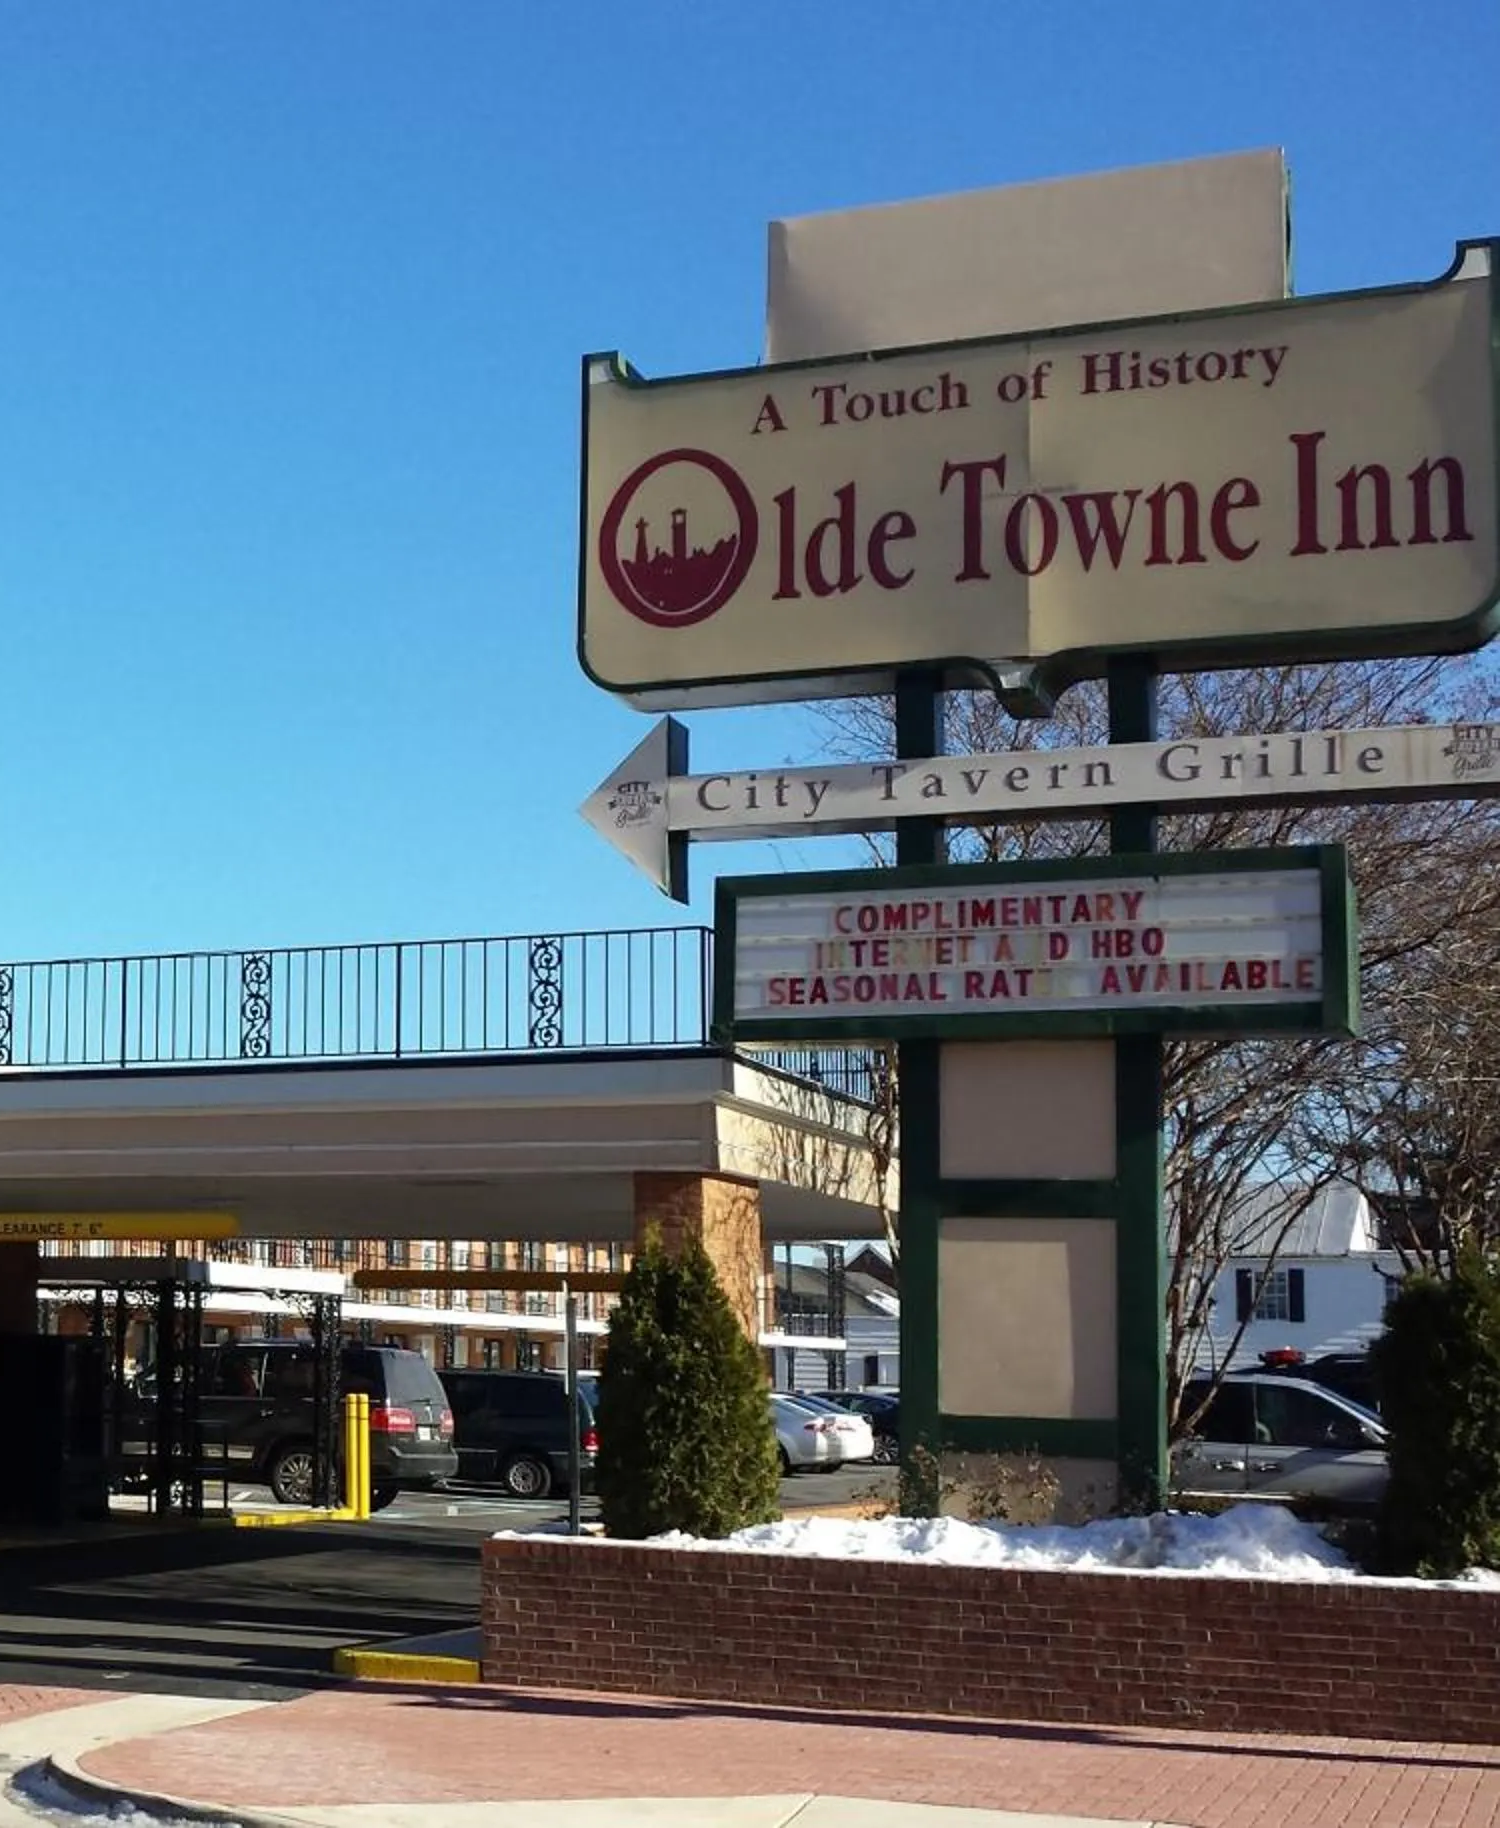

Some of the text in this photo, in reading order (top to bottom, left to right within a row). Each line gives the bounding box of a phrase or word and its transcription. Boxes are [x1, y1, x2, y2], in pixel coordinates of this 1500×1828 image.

[750, 345, 1290, 435] A Touch of History
[939, 453, 1260, 583] Towne
[1287, 430, 1475, 556] Inn
[698, 735, 1387, 817] City Tavern Grille
[835, 890, 1145, 934] COMPLIMENTARY
[991, 931, 1069, 964] AD
[1091, 927, 1166, 959] HBO
[768, 972, 947, 1005] SEASONAL
[1101, 958, 1316, 994] AVAILABLE
